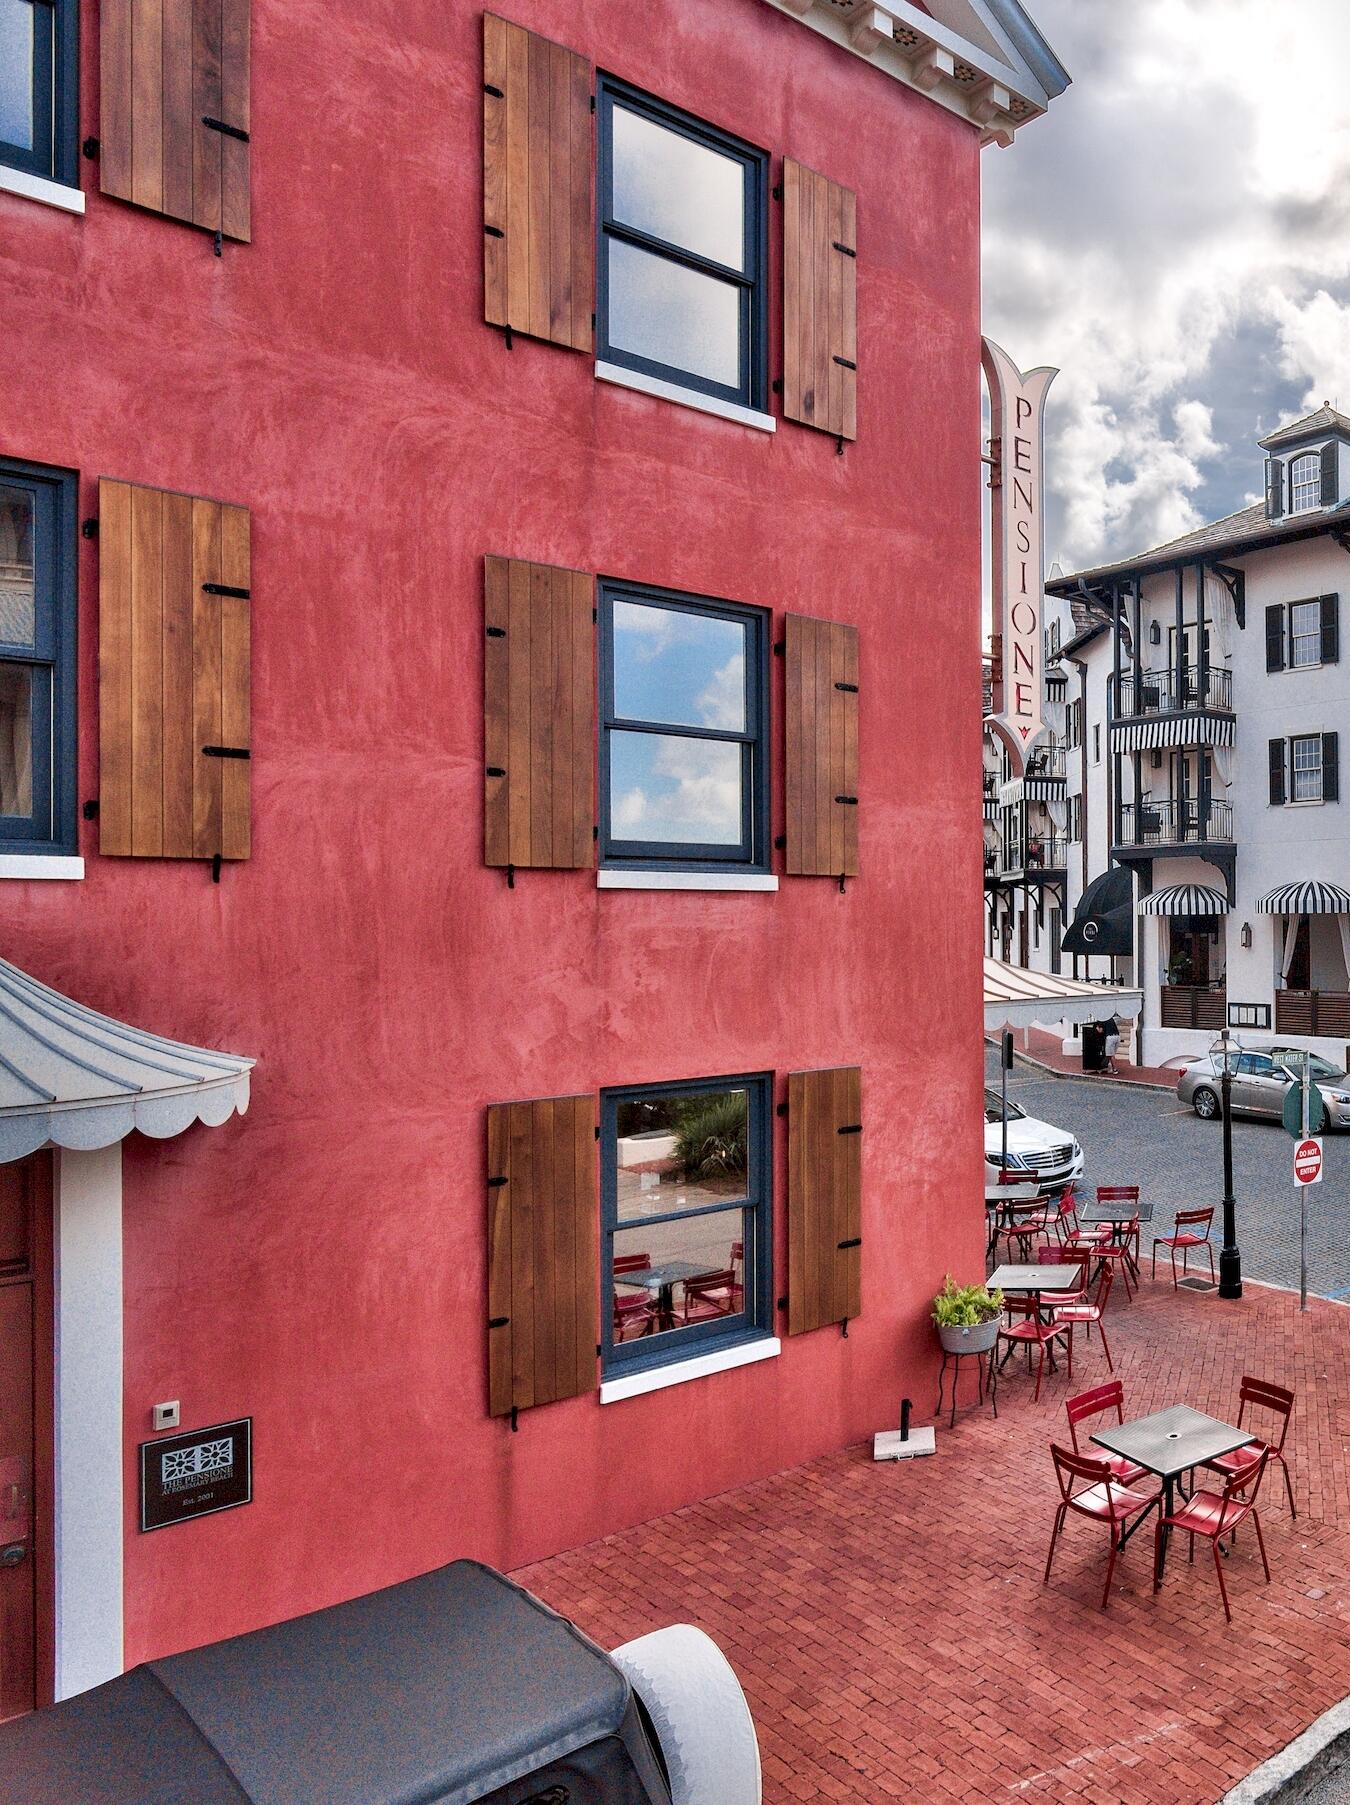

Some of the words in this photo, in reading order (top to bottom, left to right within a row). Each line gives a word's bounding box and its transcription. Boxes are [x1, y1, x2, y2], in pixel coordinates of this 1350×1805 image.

[1009, 396, 1037, 718] PENSIONE
[1273, 1054, 1284, 1064] WEST
[1285, 1053, 1298, 1063] WATER
[1299, 1150, 1307, 1158] DO
[1307, 1148, 1318, 1156] NOT
[1300, 1166, 1317, 1175] ENTER
[162, 1479, 182, 1490] THE
[185, 1466, 233, 1483] PENSIONE
[162, 1488, 171, 1496] AT
[172, 1480, 209, 1493] ROSEMARY
[210, 1472, 233, 1483] BEACH
[182, 1498, 195, 1506] Est.
[197, 1492, 214, 1502] 2001
